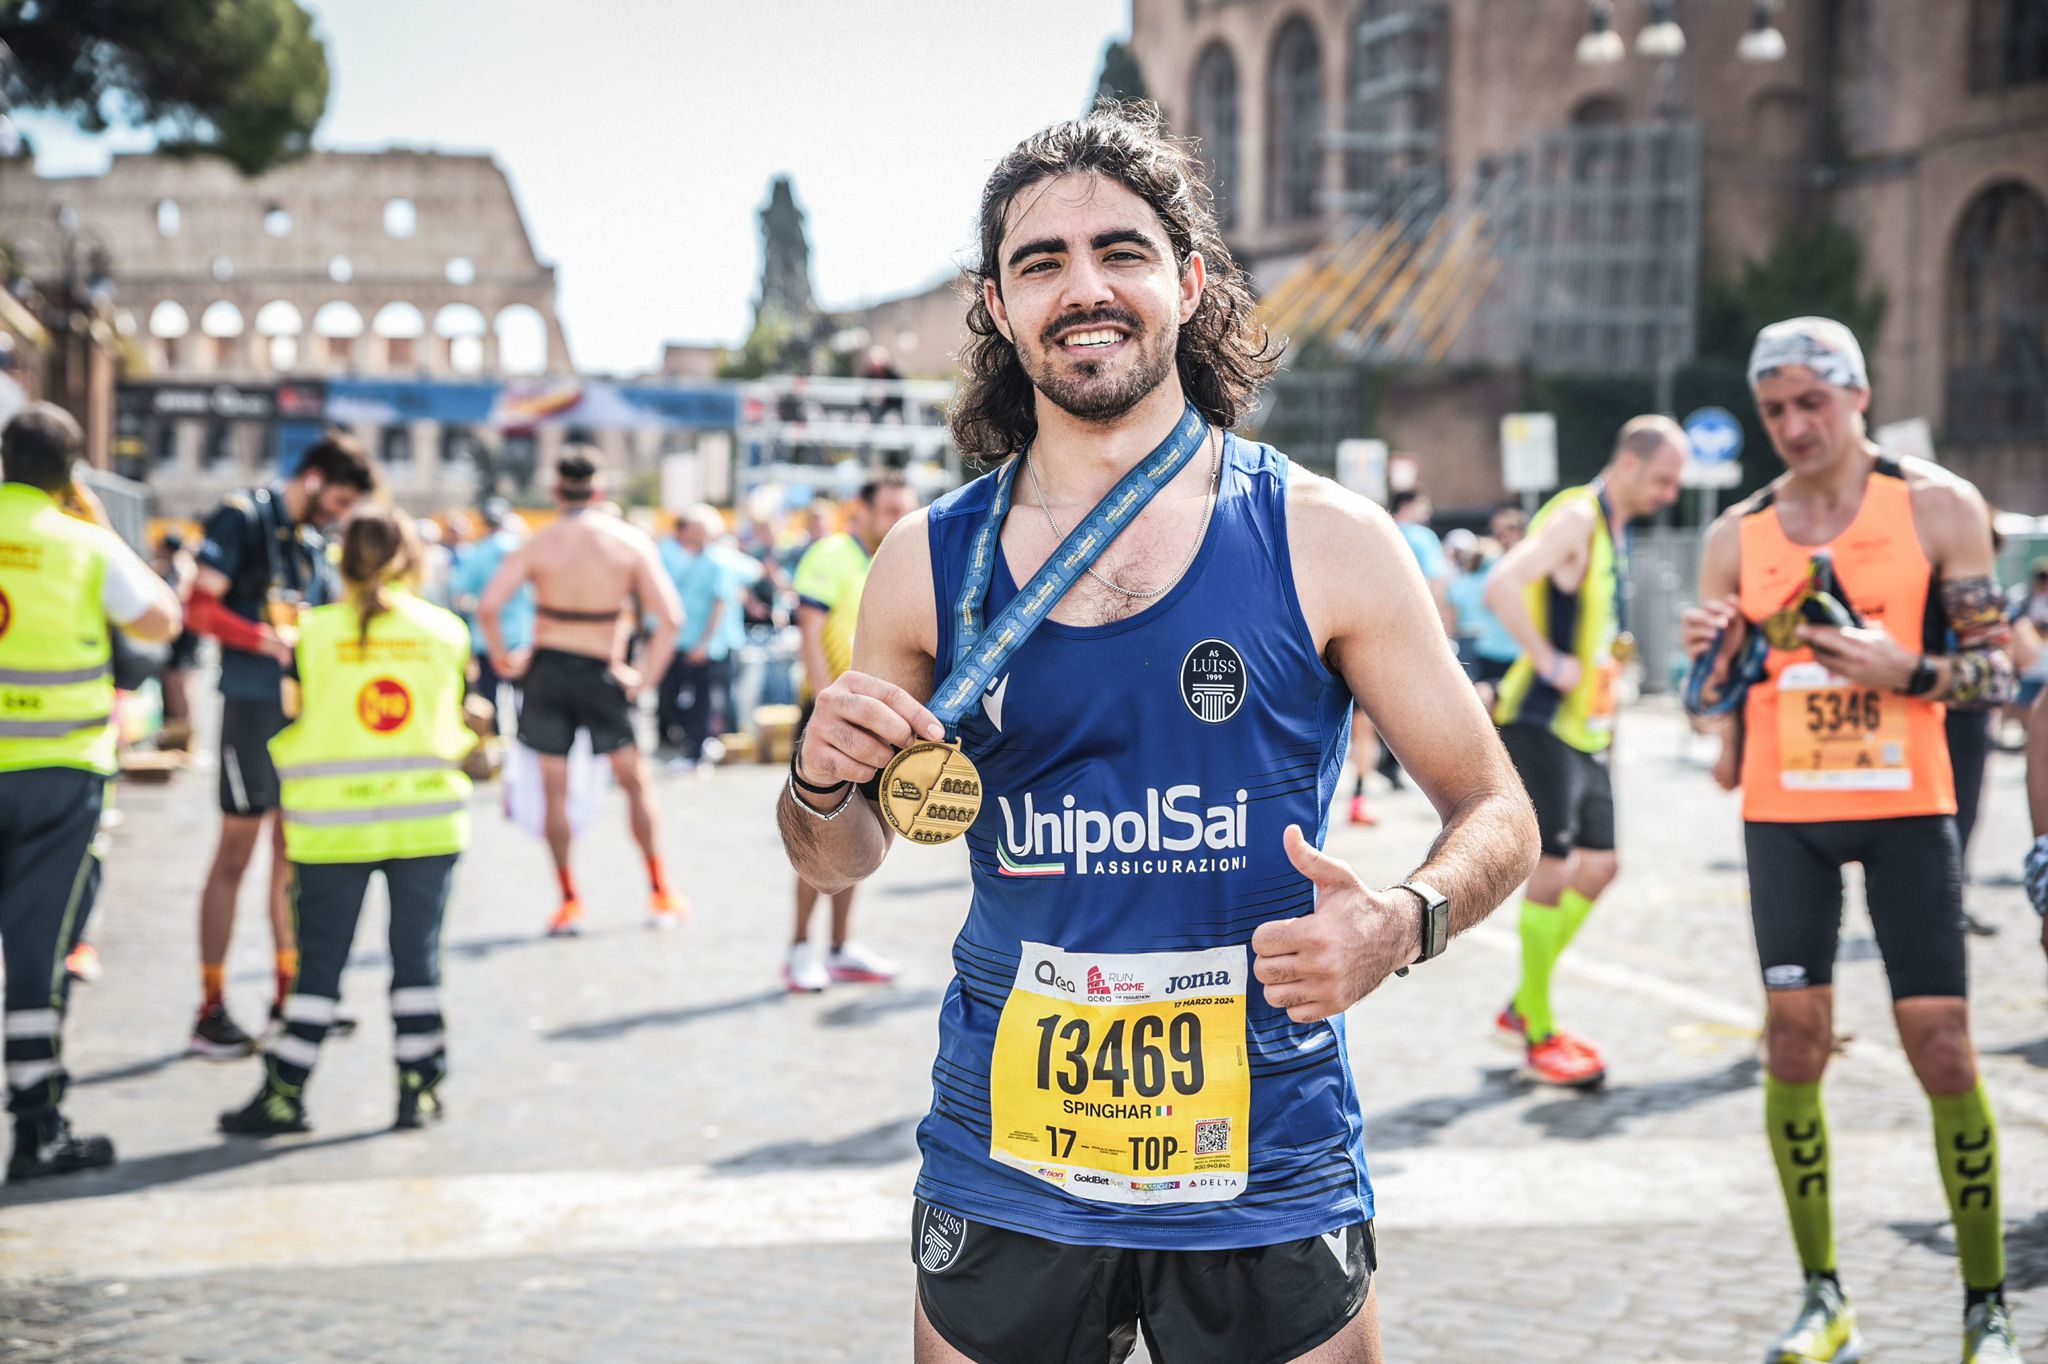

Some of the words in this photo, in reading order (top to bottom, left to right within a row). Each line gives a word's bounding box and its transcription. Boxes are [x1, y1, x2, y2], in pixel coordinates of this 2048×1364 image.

[1192, 659, 1236, 673] LUISS
[1806, 690, 1881, 732] 5346
[997, 784, 1248, 874] UnipolSai
[1094, 856, 1246, 874] ASSICURAZIONI
[1108, 973, 1134, 982] RUN
[1114, 982, 1144, 992] ROME
[1183, 998, 1212, 1007] MARZO
[1214, 997, 1234, 1005] 2024
[1036, 1012, 1205, 1098] 13469
[1063, 1099, 1152, 1119] SPINGHAR
[1046, 1124, 1077, 1159] 17
[1128, 1136, 1178, 1170] TOP
[932, 1208, 962, 1235] LUISS
